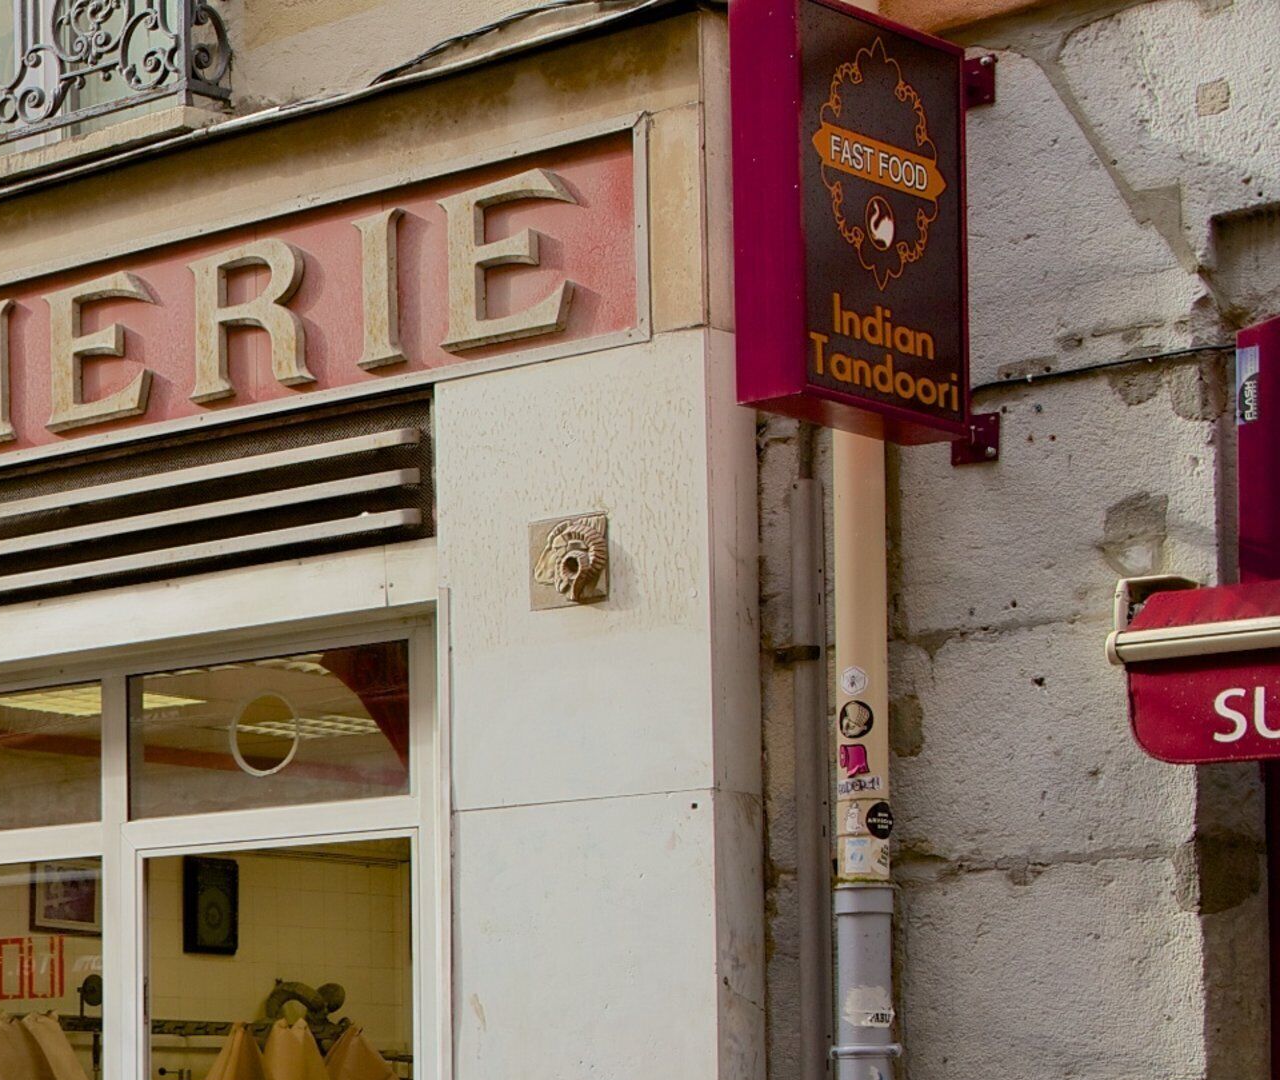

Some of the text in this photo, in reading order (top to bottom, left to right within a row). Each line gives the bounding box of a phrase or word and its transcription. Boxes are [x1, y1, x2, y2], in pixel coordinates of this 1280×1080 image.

[830, 134, 929, 192] FAST FOOD
[832, 291, 936, 361] Indian
[809, 330, 960, 413] Tandoori
